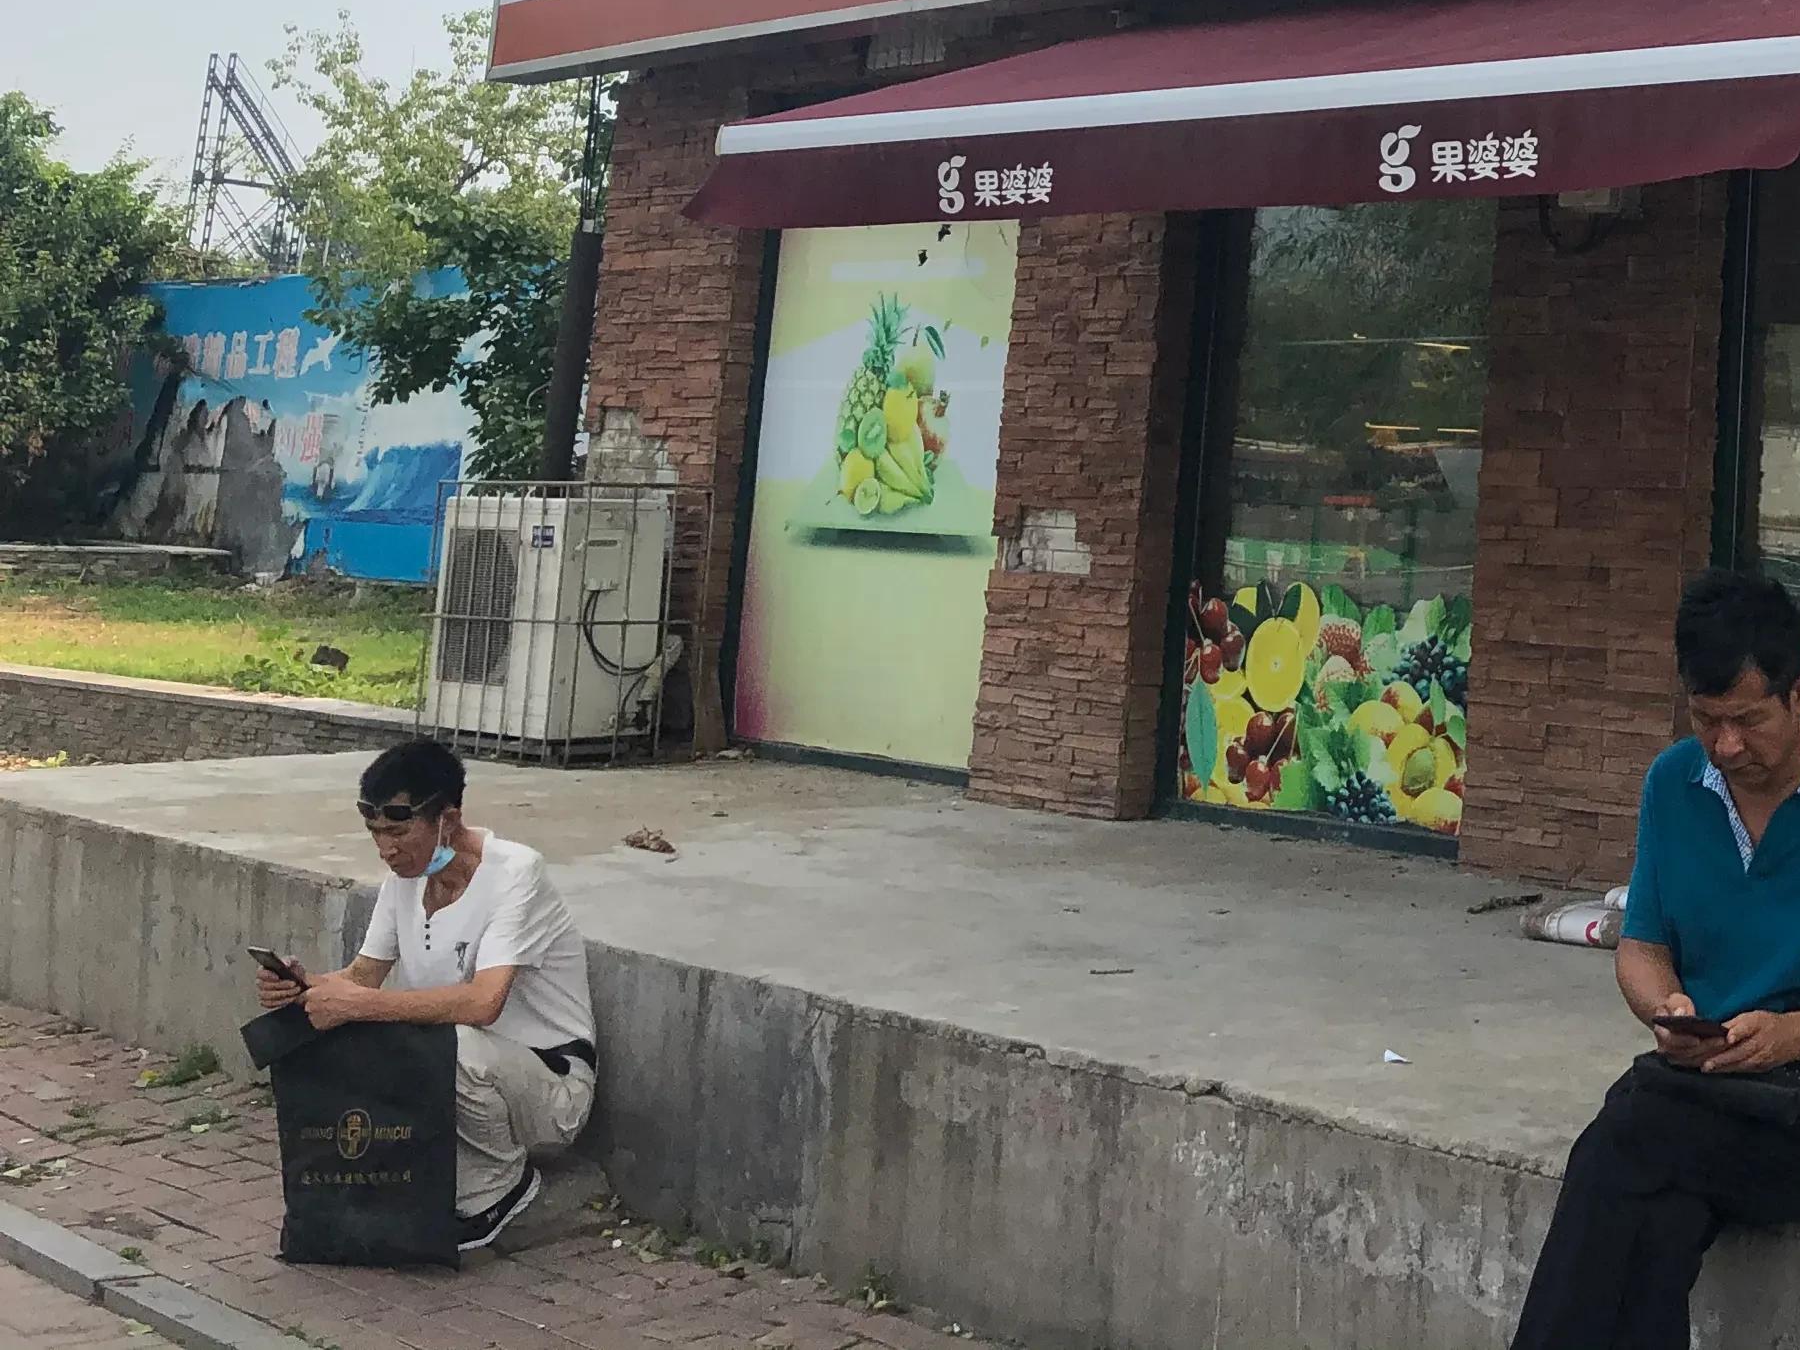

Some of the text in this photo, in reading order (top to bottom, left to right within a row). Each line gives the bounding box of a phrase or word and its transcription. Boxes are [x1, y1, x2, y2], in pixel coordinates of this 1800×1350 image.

[1430, 128, 1540, 184] 果婆婆
[973, 160, 1055, 208] 果婆婆
